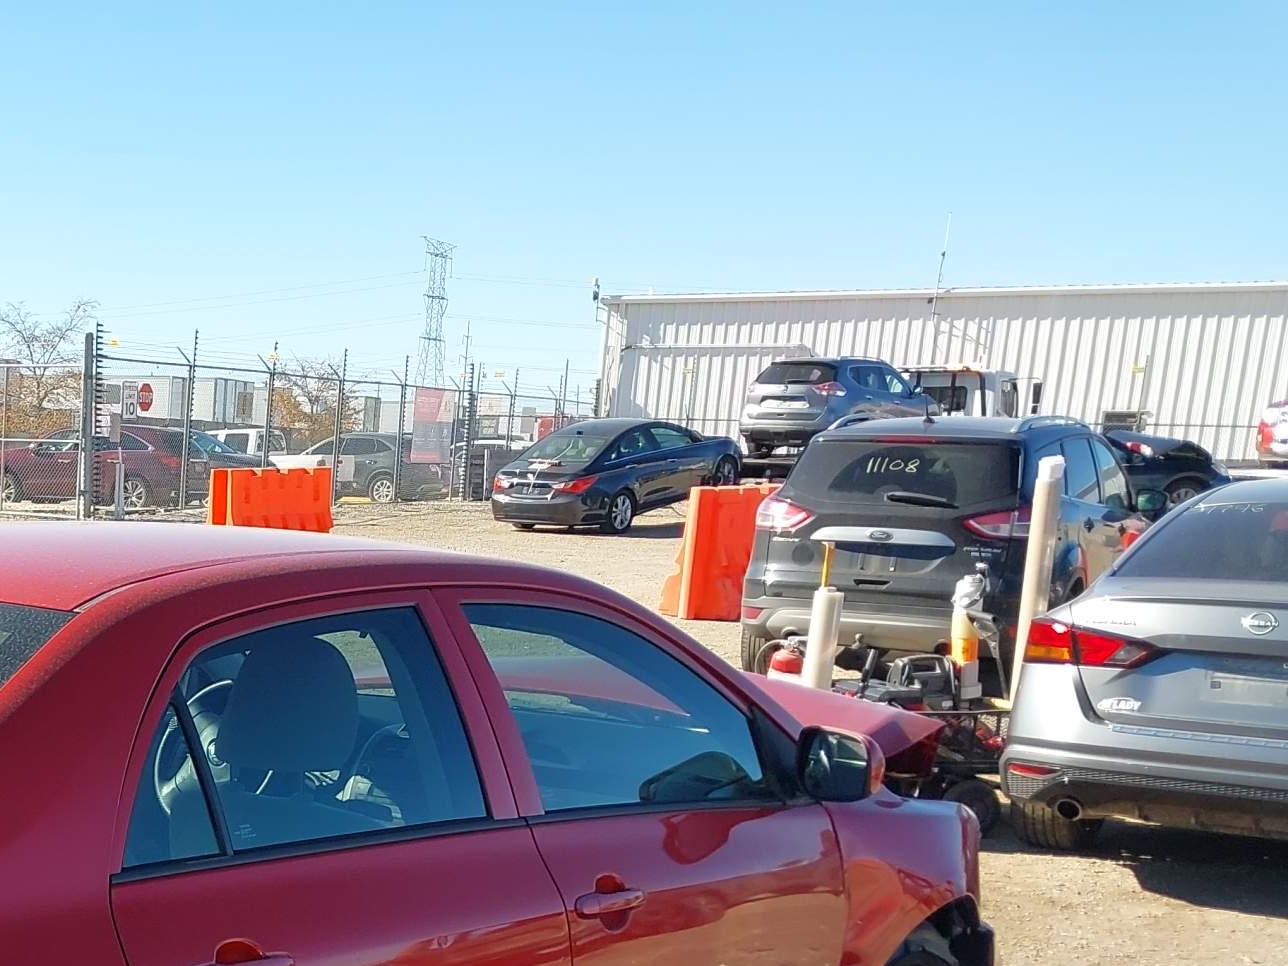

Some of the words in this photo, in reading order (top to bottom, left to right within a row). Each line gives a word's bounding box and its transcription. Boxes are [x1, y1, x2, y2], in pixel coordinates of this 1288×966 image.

[139, 391, 153, 403] STOP
[125, 402, 135, 415] 10
[866, 456, 920, 474] 11108
